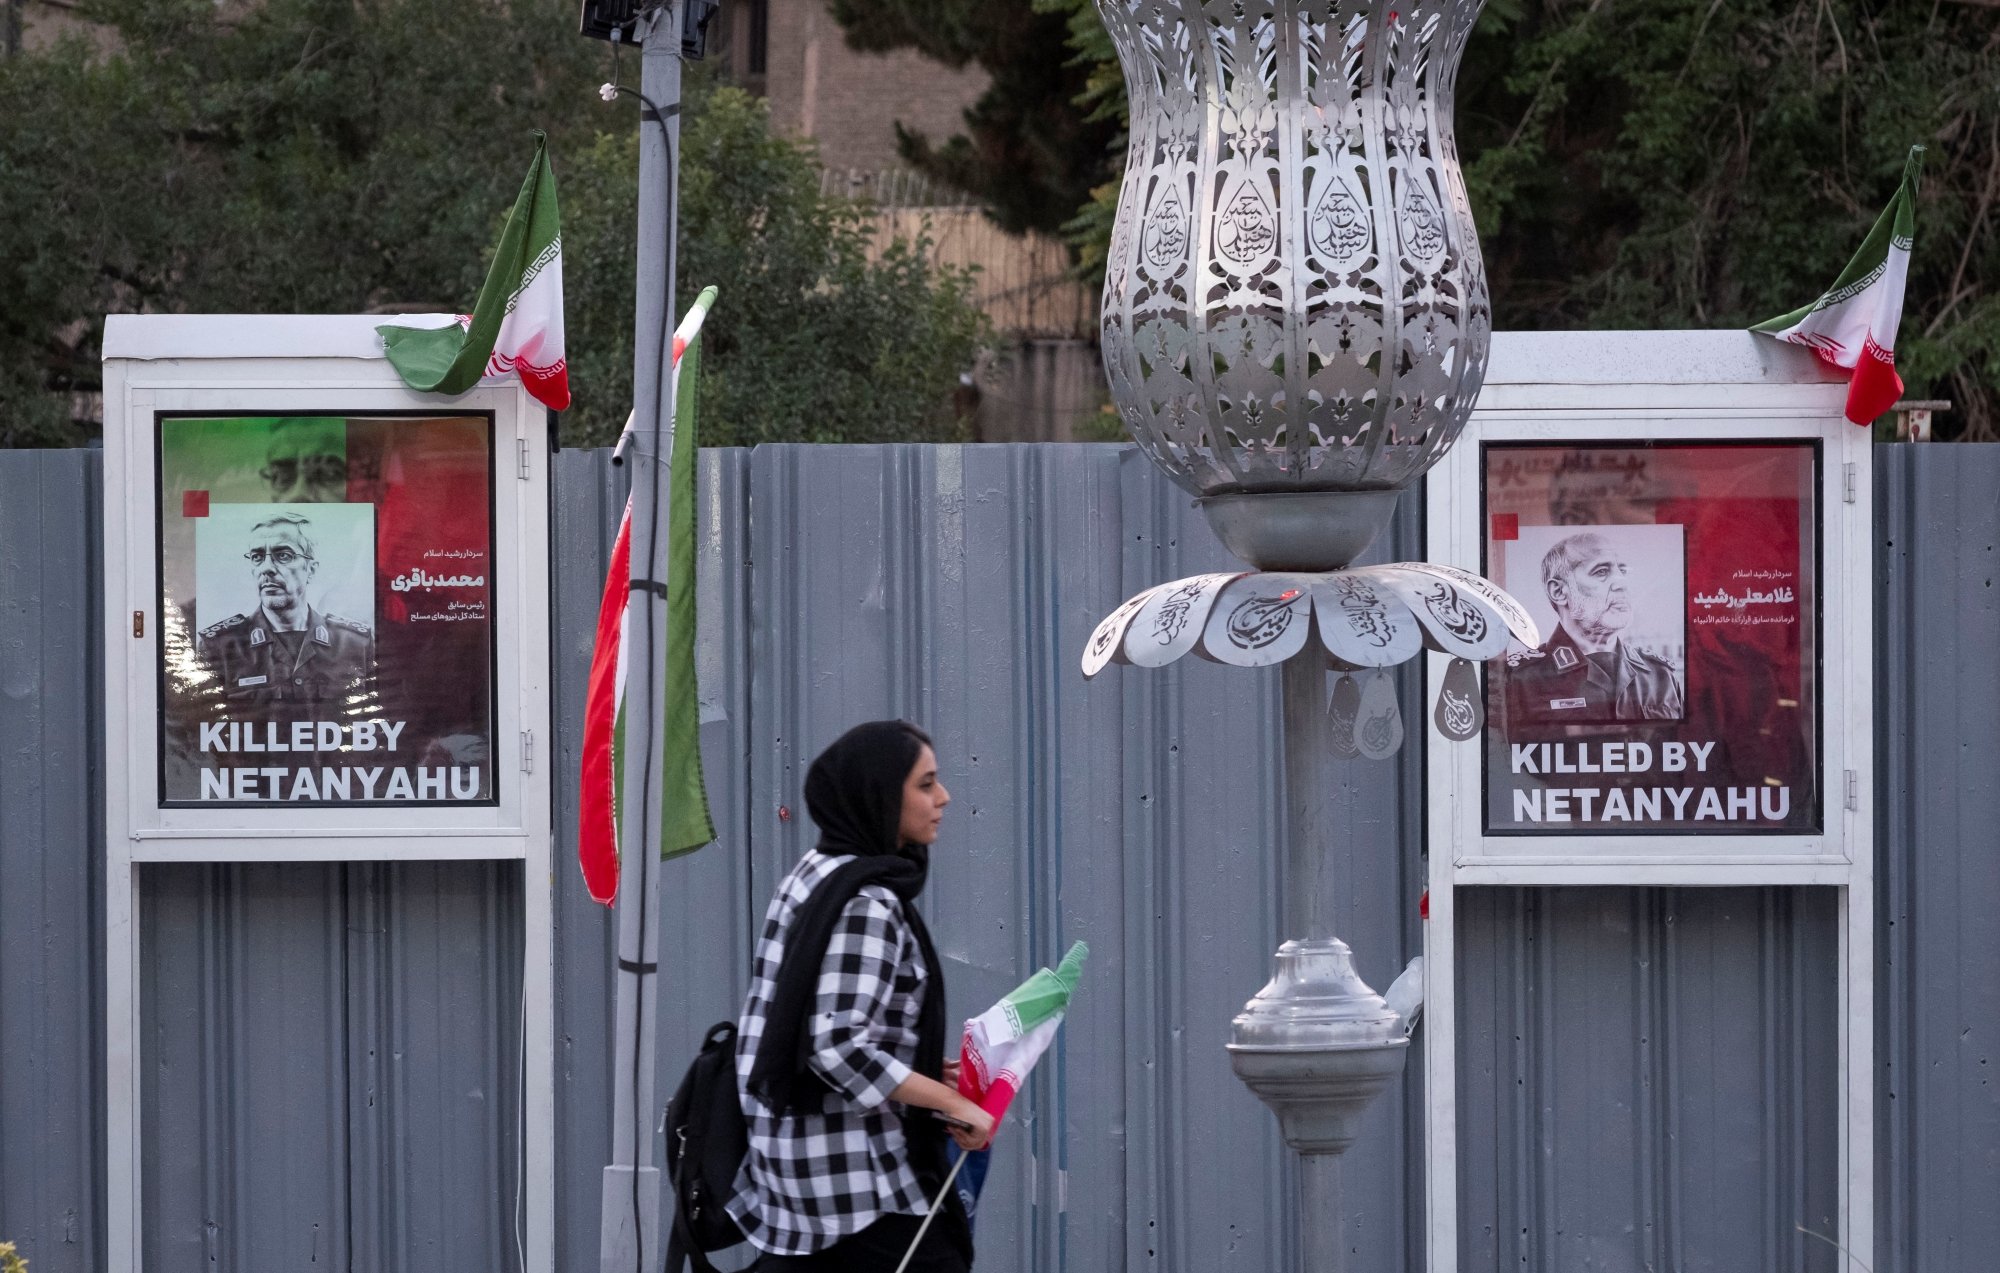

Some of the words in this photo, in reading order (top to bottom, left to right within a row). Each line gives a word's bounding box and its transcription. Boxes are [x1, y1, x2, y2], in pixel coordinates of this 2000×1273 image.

[423, 549, 444, 559] اسلام
[444, 549, 463, 559] رشید
[463, 549, 484, 559] سردار
[1732, 569, 1753, 579] اسلام
[1753, 569, 1772, 579] رشید
[1772, 569, 1792, 579] سردار
[390, 567, 434, 593] باقری
[434, 574, 485, 587] محمد
[1693, 587, 1734, 609] رشید
[447, 600, 466, 610] سابق
[410, 611, 431, 622] مسلح
[431, 612, 457, 621] نیروهای
[457, 611, 469, 621] کل
[469, 611, 485, 620] ستاد
[1752, 615, 1770, 625] سابق
[200, 721, 343, 752] KILLED
[352, 721, 406, 752] BY
[1511, 742, 1653, 773] KILLED
[1662, 741, 1716, 772] BY
[200, 766, 480, 800] NETANYAHU
[1513, 786, 1790, 822] NETANYAHU
